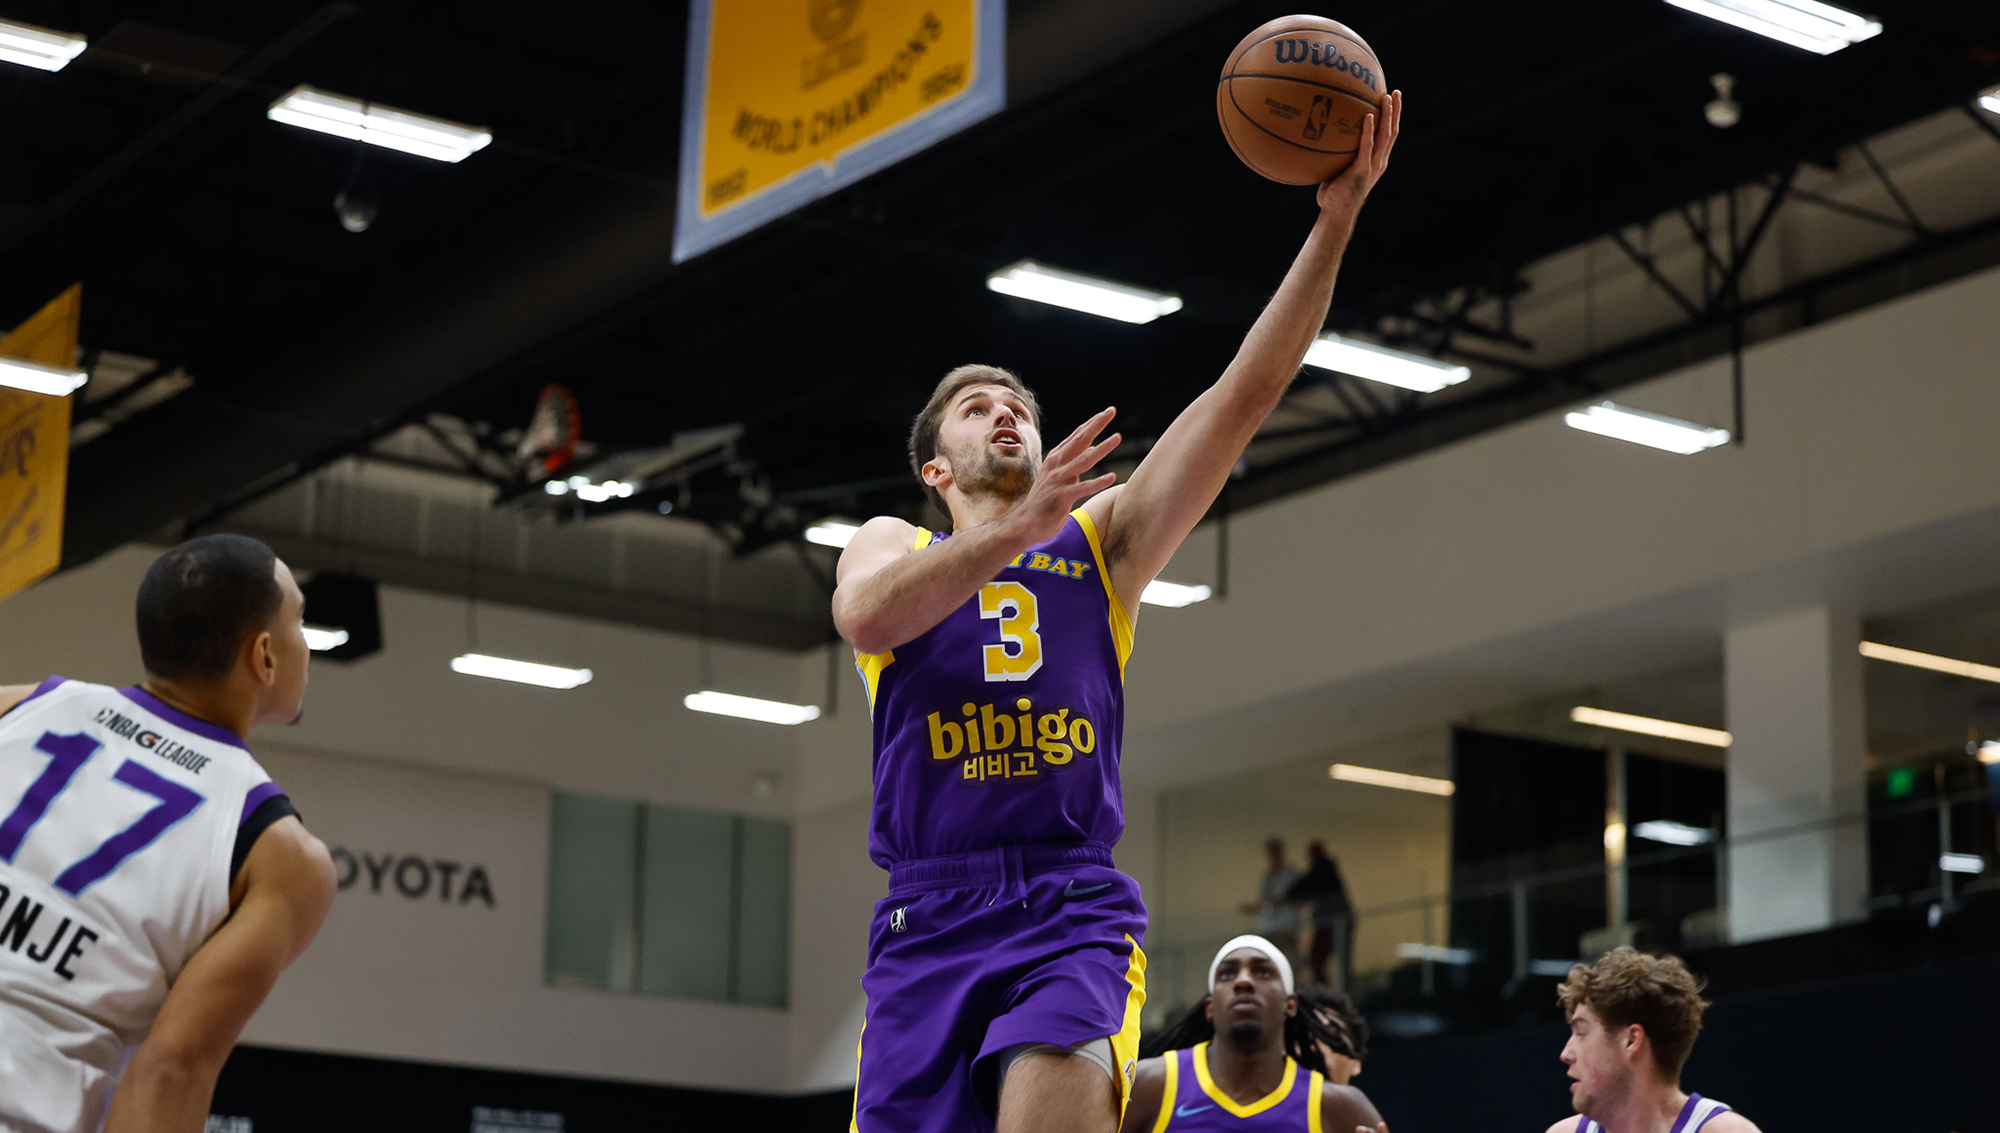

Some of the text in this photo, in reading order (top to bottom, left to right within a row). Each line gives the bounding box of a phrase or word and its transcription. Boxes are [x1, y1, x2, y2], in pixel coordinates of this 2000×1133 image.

[1273, 39, 1378, 92] Wilson
[1027, 552, 1092, 579] BAY
[979, 581, 1043, 682] 3
[105, 713, 141, 740] NBA
[154, 738, 212, 775] LEAGUE
[927, 697, 1096, 765] bibigo
[963, 752, 1038, 781] 비비고
[0, 730, 207, 899] 17
[330, 847, 496, 909] OYOTA
